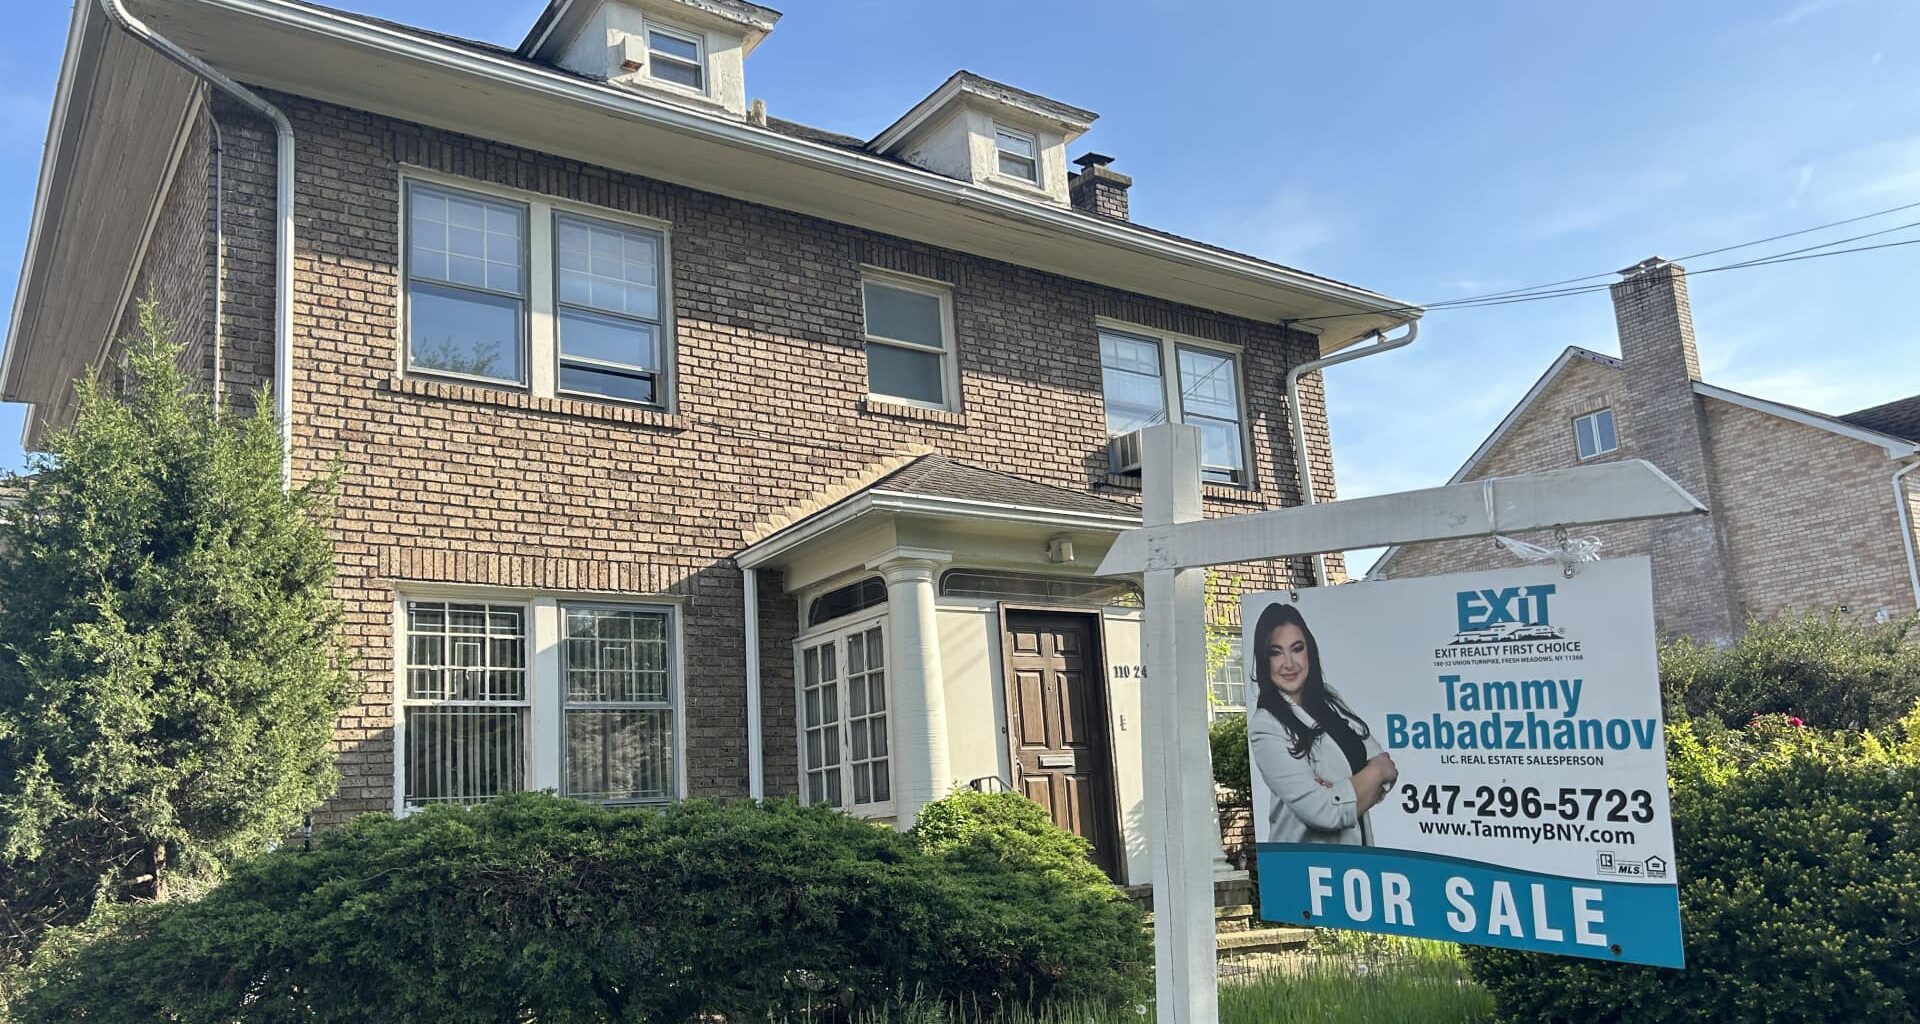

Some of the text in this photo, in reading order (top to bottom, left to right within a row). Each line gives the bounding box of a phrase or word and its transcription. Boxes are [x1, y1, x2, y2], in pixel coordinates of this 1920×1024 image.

[1435, 641, 1581, 659] EXIT REALTY FIRST CHOICE
[1113, 665, 1130, 678] 110
[1438, 675, 1583, 717] Tammy
[1386, 711, 1657, 751] Babadzhanov
[1440, 755, 1604, 766] LIC. REAL ESTATE SALESPERSON
[1400, 783, 1655, 824] 347-296-5723
[1419, 820, 1635, 845] www.TammyBNY.com
[1308, 866, 1608, 947] FOR SALE
